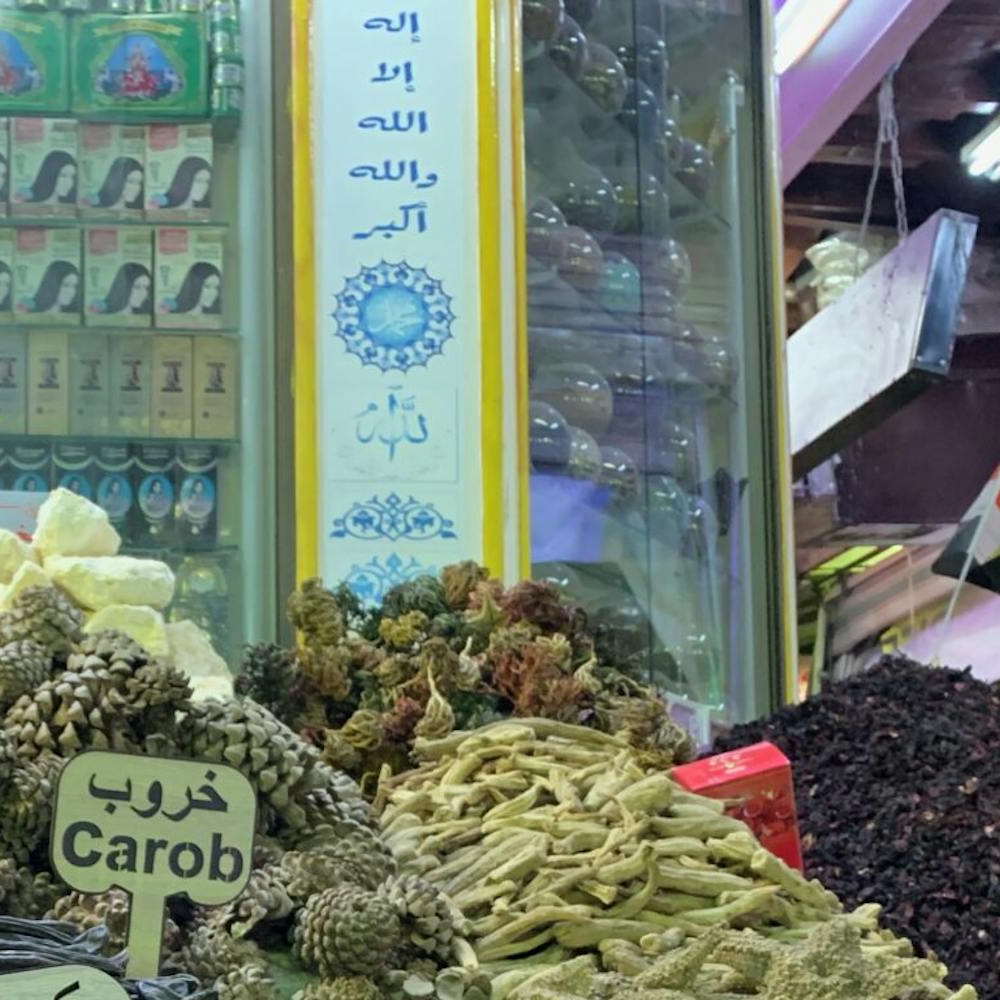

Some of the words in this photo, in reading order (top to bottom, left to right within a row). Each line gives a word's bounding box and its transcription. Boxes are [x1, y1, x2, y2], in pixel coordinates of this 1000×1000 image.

[363, 11, 421, 43] إله
[371, 61, 415, 93] إلا
[358, 110, 429, 134] الله
[349, 159, 438, 189] والله
[89, 769, 228, 822] خروب
[62, 821, 244, 883] Carob
